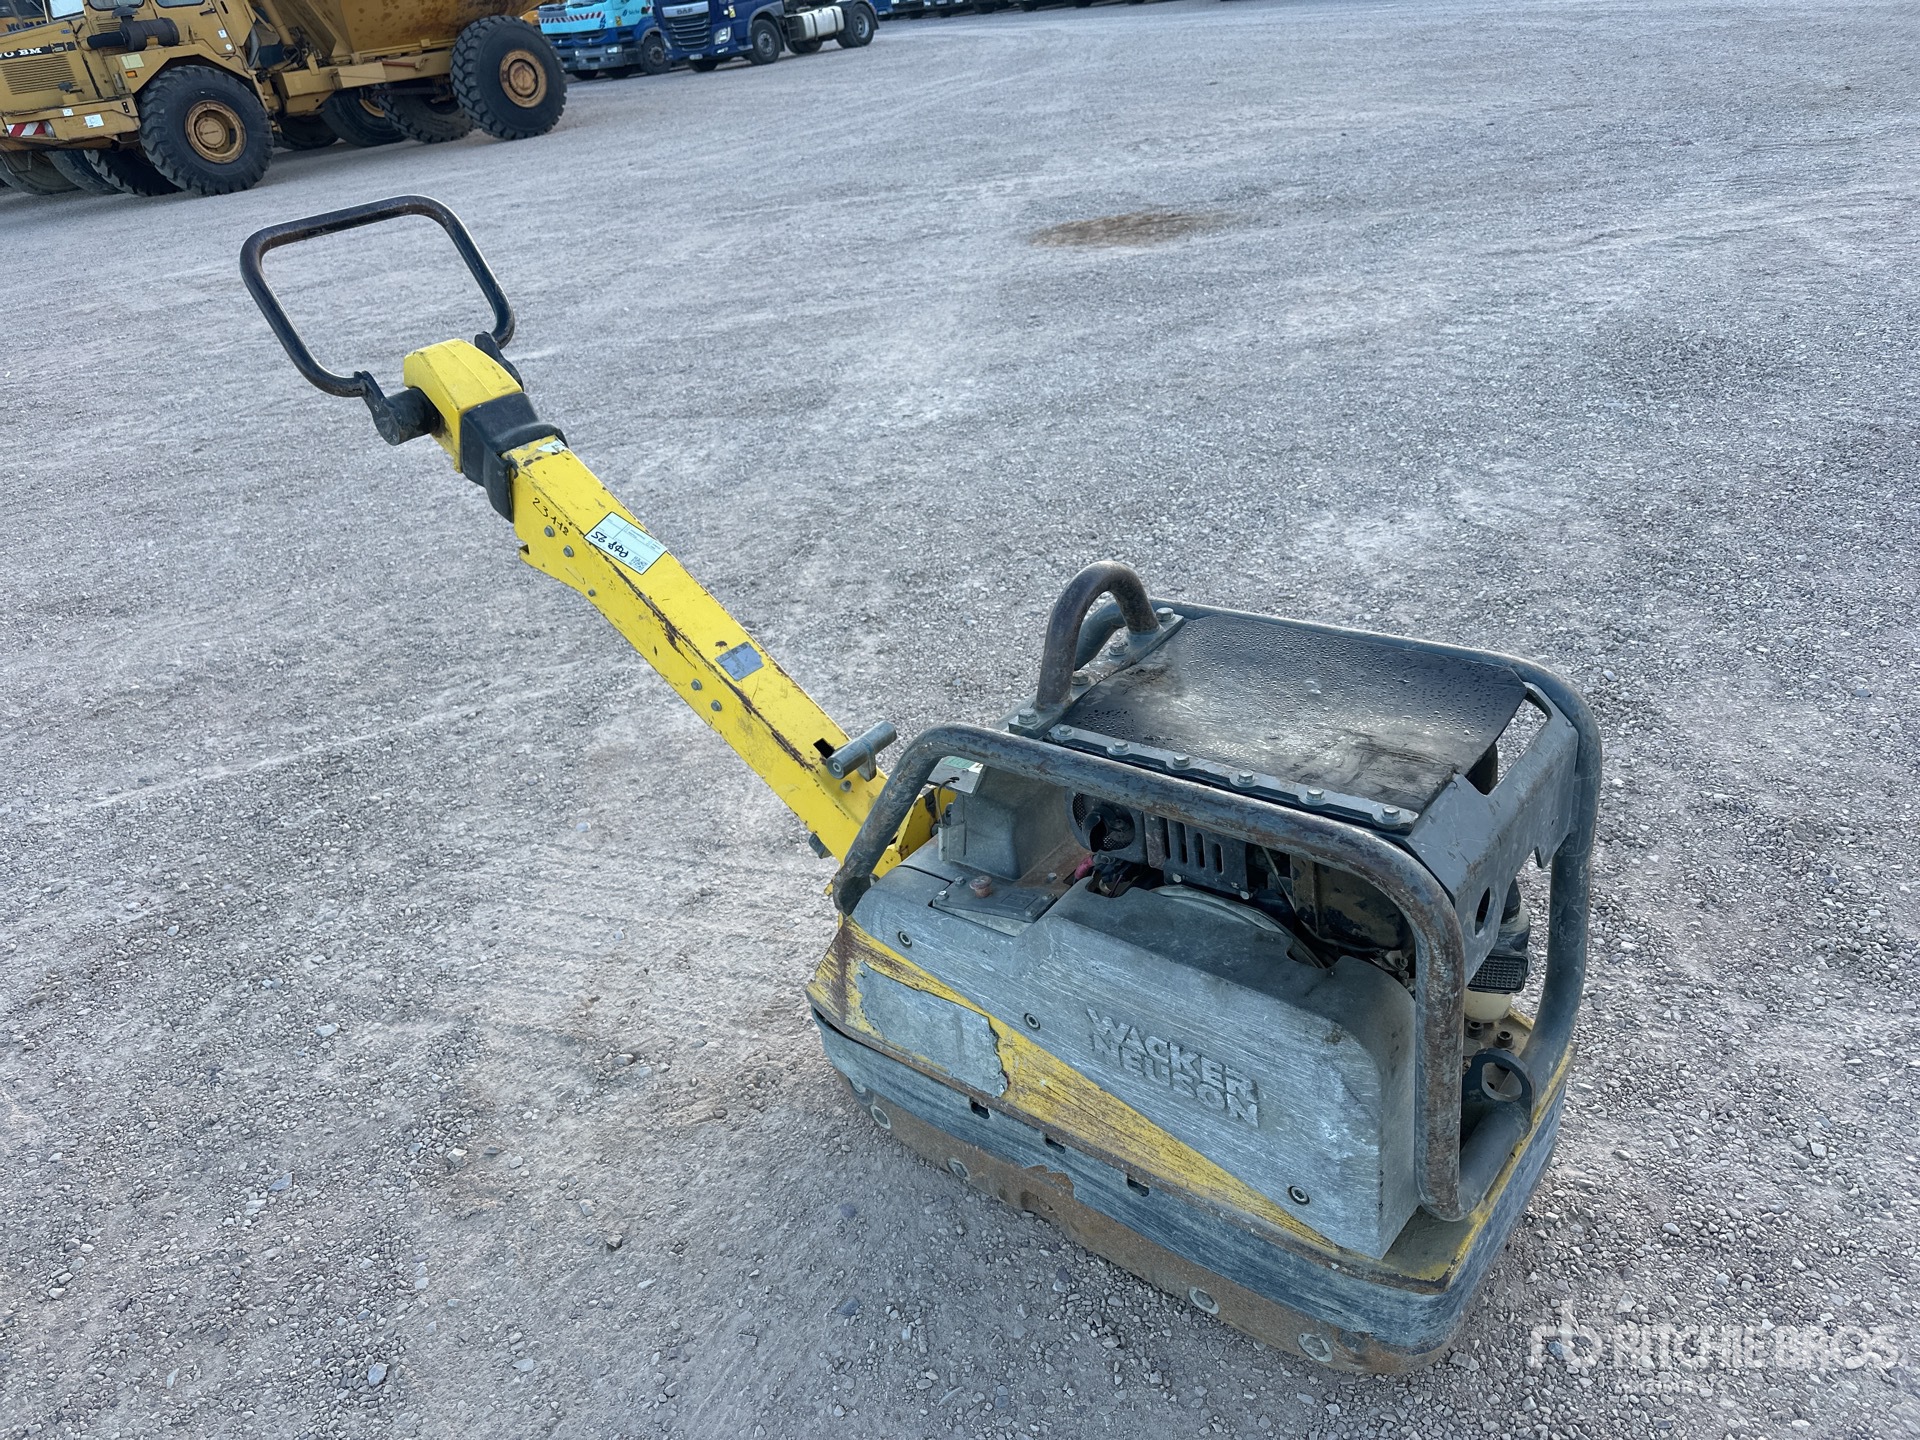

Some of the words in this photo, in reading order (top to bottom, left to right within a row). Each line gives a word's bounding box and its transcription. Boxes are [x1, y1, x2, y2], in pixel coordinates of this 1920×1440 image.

[18, 47, 42, 56] BM
[1085, 1006, 1259, 1101] WACKER
[1088, 1033, 1260, 1129] NEUSON
